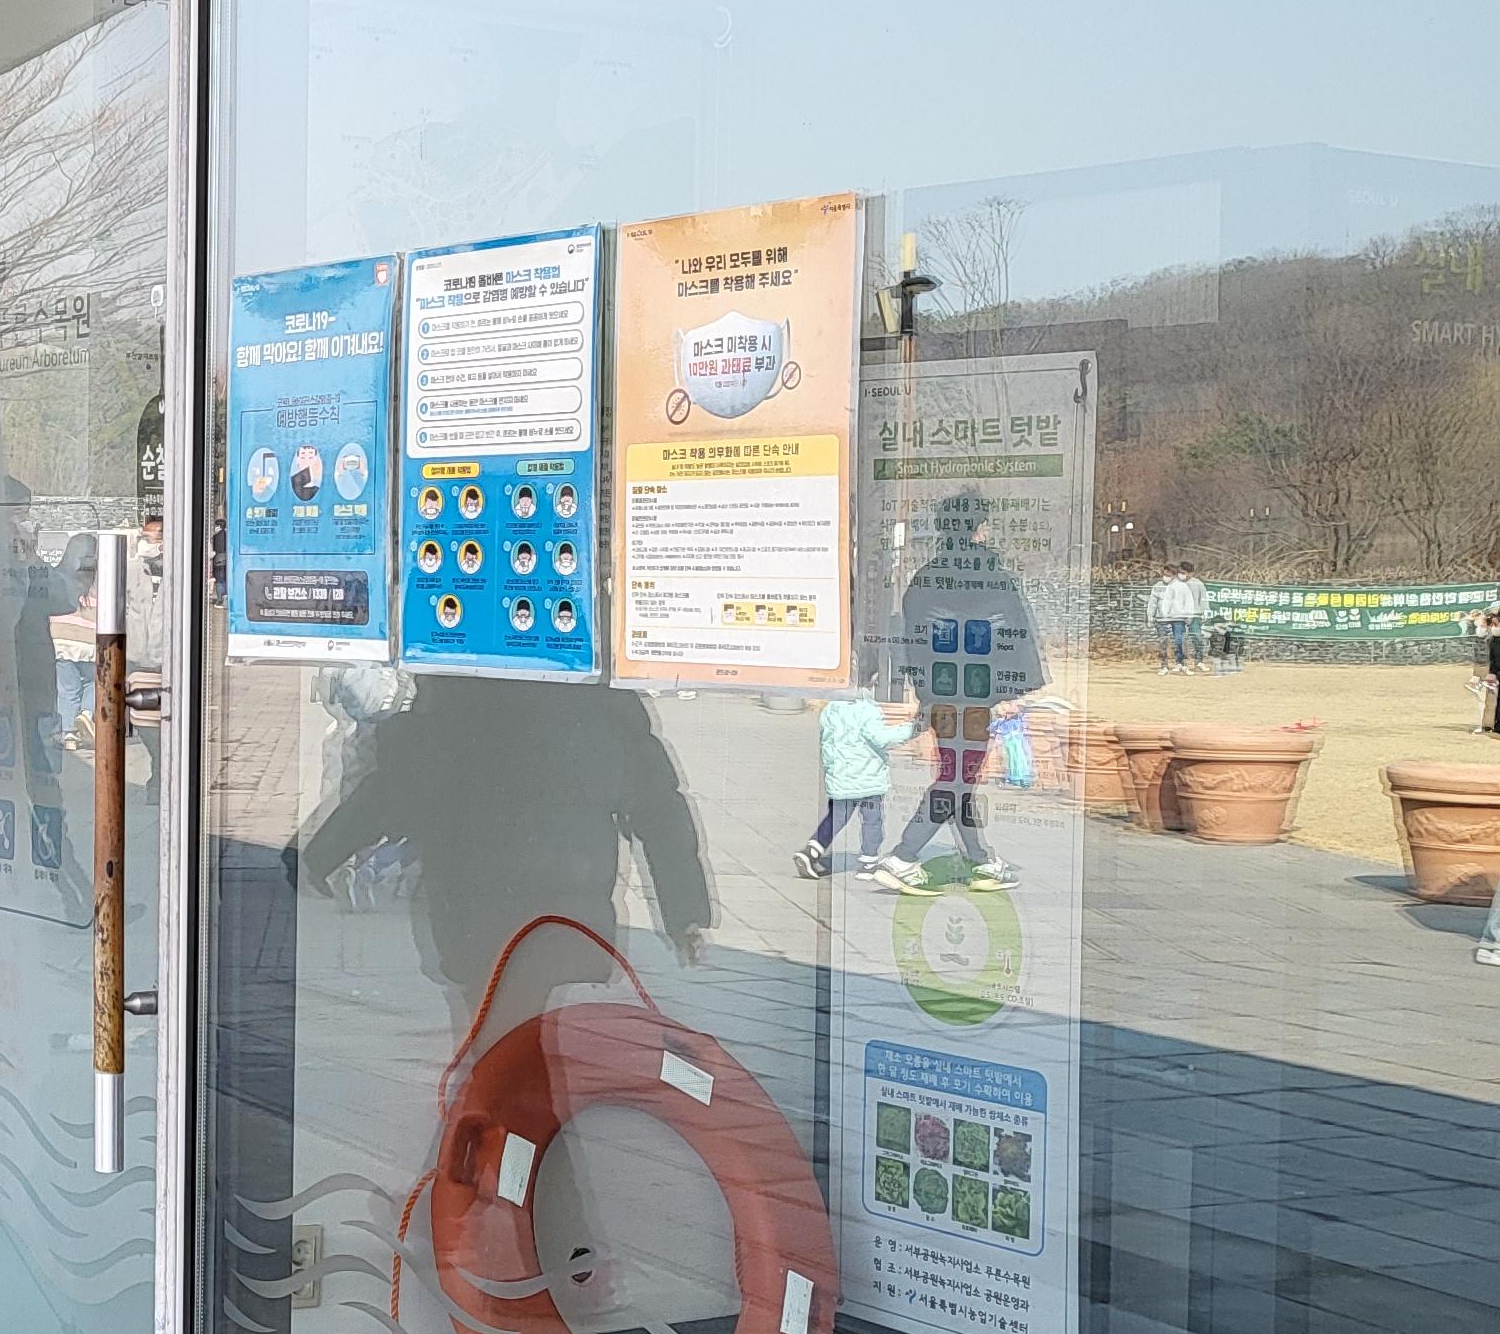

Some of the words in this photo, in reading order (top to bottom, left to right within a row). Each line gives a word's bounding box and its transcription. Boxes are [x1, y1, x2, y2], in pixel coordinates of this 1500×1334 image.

[705, 254, 727, 273] 우리
[729, 250, 762, 269] 모두를
[766, 246, 788, 264] 위해
[506, 269, 531, 284] 마스크
[677, 278, 720, 298] 마스크를
[723, 274, 756, 293] 착용해
[448, 291, 481, 307] 착용으로
[539, 285, 548, 298] 수
[236, 344, 261, 368] 함께
[263, 340, 301, 365] 막아요!
[304, 338, 329, 361] 함께
[331, 331, 384, 357] 이겨내요!
[693, 337, 724, 357] 마스크
[727, 335, 759, 354] 미착용
[761, 334, 772, 352] 시
[32, 347, 91, 368] Arboretum
[688, 359, 718, 377] 10만원
[721, 356, 752, 375] 과태료
[754, 355, 776, 372] 부과
[276, 405, 340, 428] 예방행동수칙
[879, 419, 924, 452] 실내
[930, 418, 1003, 447] 스마트
[1010, 414, 1062, 448] 텃밭
[662, 448, 687, 460] 마스크
[708, 445, 741, 458] 의무화에
[743, 444, 761, 457] 따른
[763, 443, 780, 456] 단속
[782, 442, 800, 455] 안내
[897, 461, 928, 475] Smart
[931, 460, 994, 477] Hydroponic
[996, 458, 1037, 476] System
[881, 499, 897, 512] IoT
[942, 497, 969, 512] 실내용
[953, 557, 981, 571] 채소를
[913, 624, 928, 635] 크기
[877, 1062, 886, 1076] 한
[941, 1075, 949, 1089] 후
[1014, 1090, 1033, 1107] 이용
[933, 1059, 951, 1075] 실내
[953, 1064, 981, 1079] 스마트
[984, 1070, 1022, 1088] 텃밭에서
[880, 1086, 895, 1099] 실내
[896, 1089, 917, 1103] 스마트
[918, 1093, 947, 1110] 텃밭에서
[948, 1100, 963, 1114] 재배
[964, 1103, 987, 1119] 가능한
[904, 1243, 982, 1275] 서부공원녹지사업소
[984, 1265, 1031, 1290] 푸른수목원
[904, 1266, 981, 1298] 서부공원녹지사업소
[983, 1289, 1030, 1313] 공원운영과
